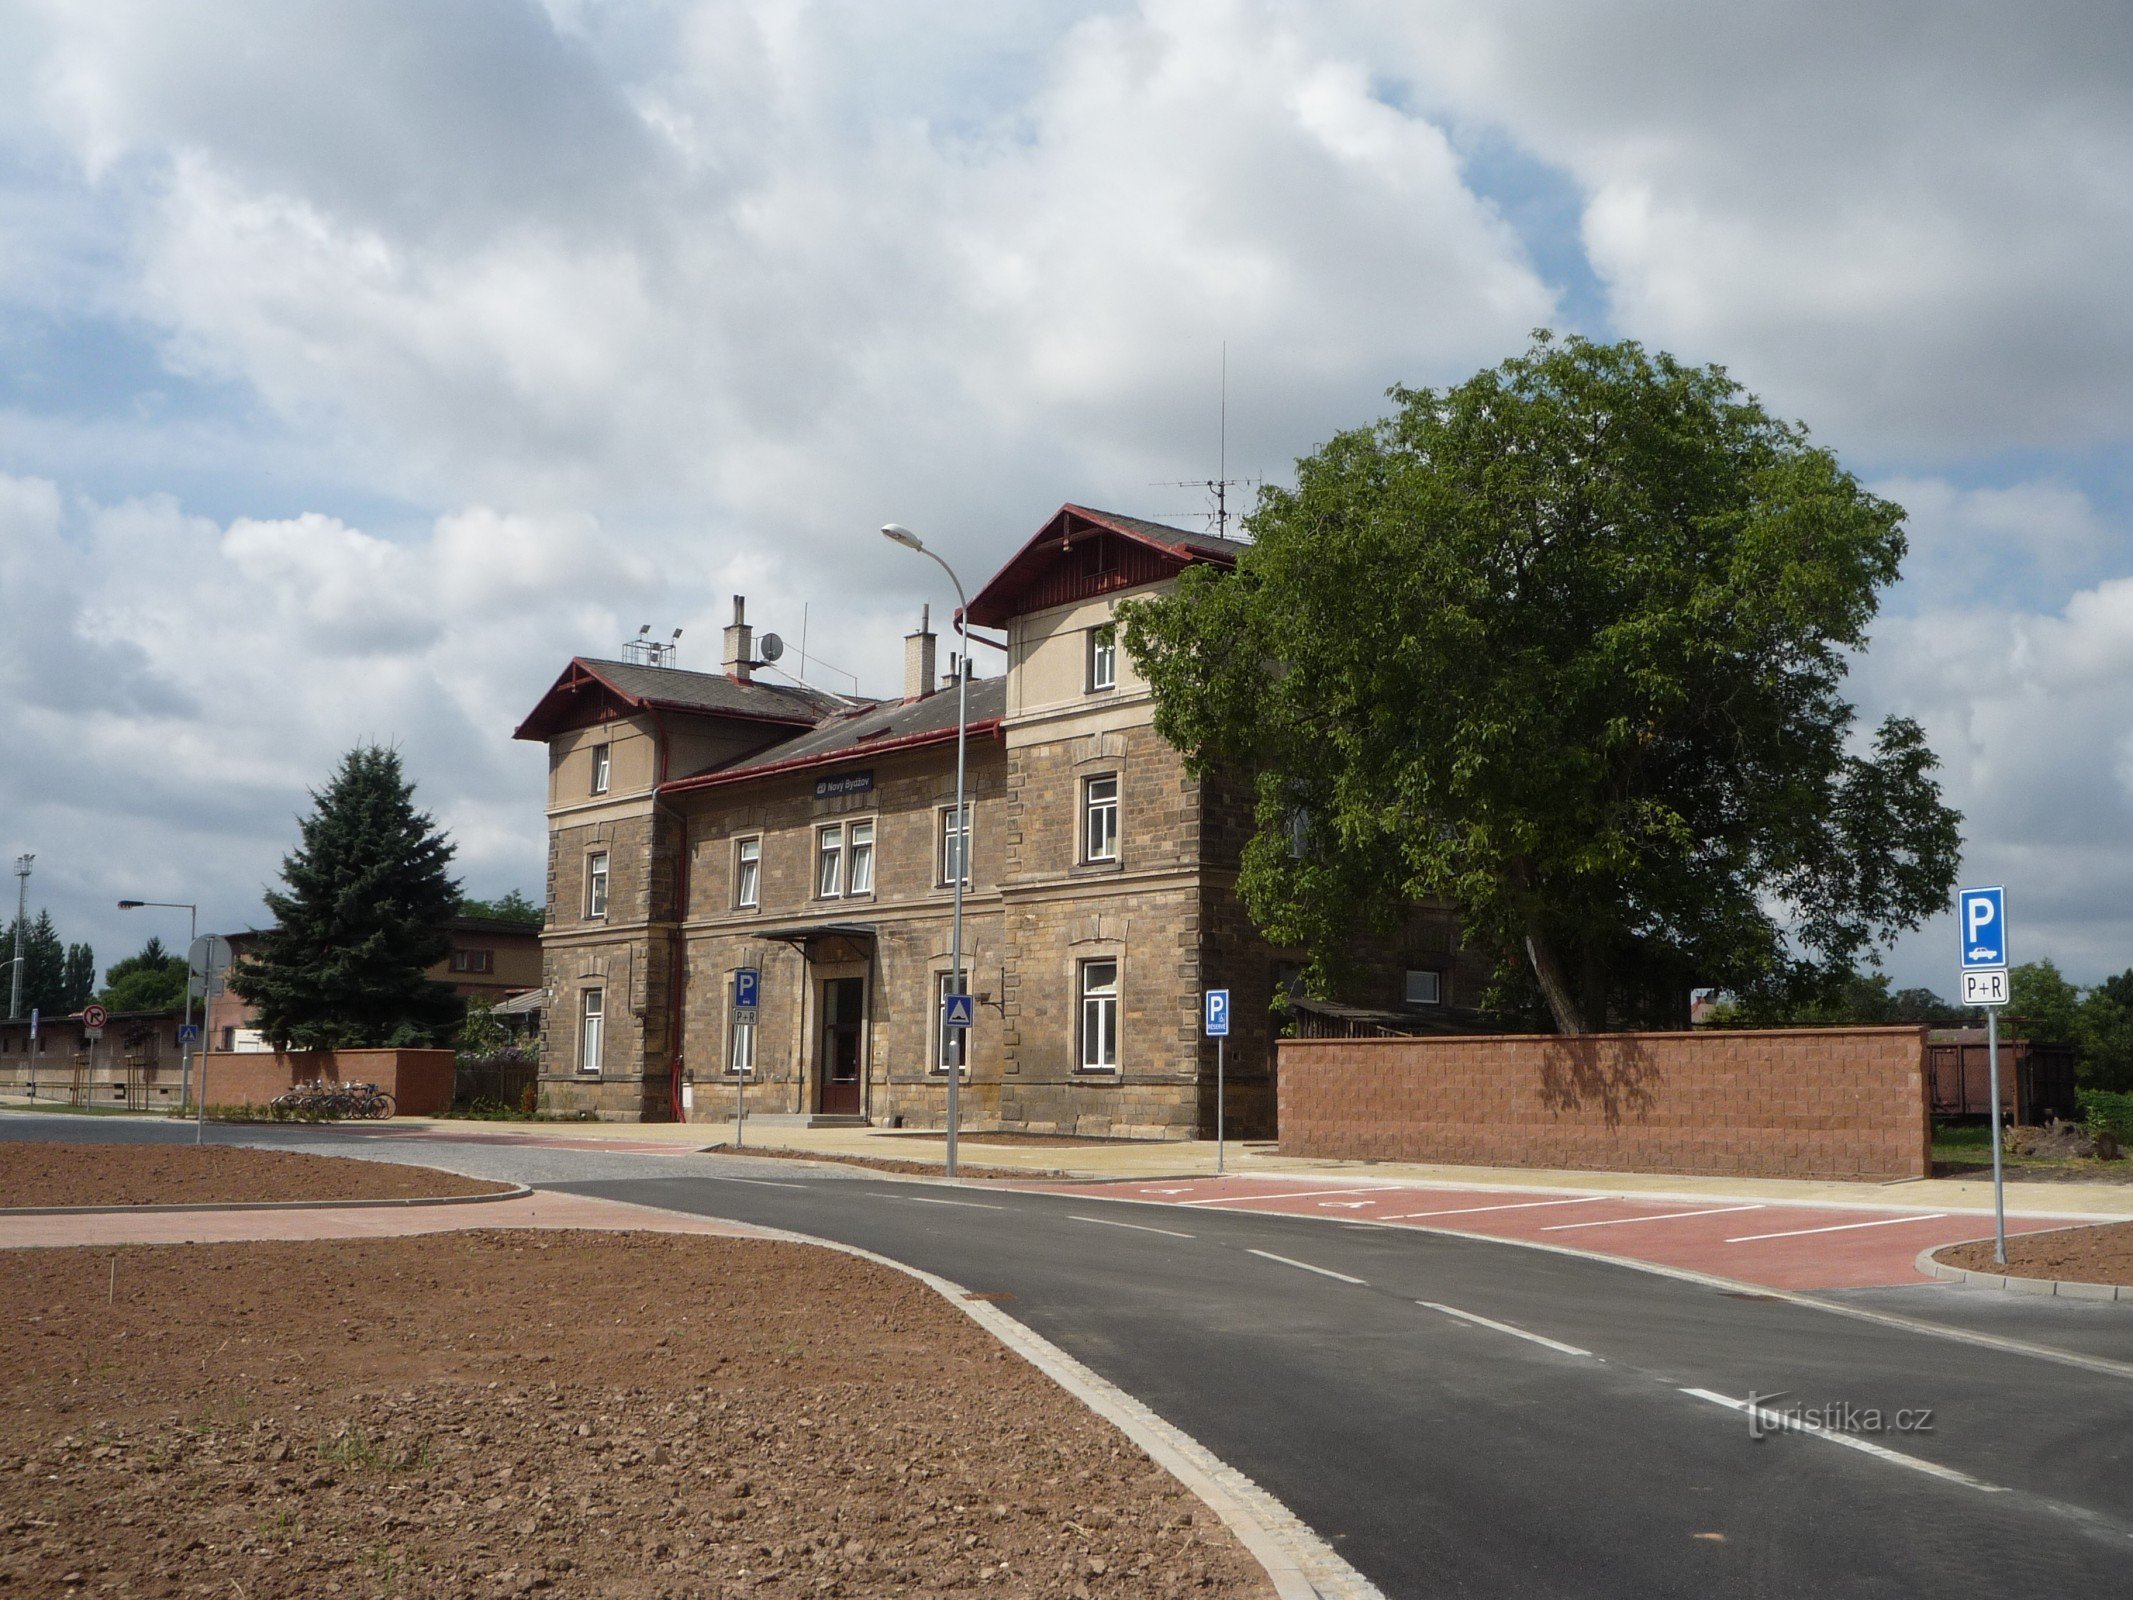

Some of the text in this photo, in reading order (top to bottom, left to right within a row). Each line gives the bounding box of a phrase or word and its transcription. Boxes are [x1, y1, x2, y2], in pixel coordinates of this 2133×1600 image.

[828, 780, 844, 792] Nový
[845, 777, 870, 791] Bydžov
[1969, 898, 1994, 943] P
[739, 975, 754, 996] P
[1968, 976, 2002, 998] P+R
[736, 1011, 755, 1023] P+R
[1210, 996, 1223, 1021] P
